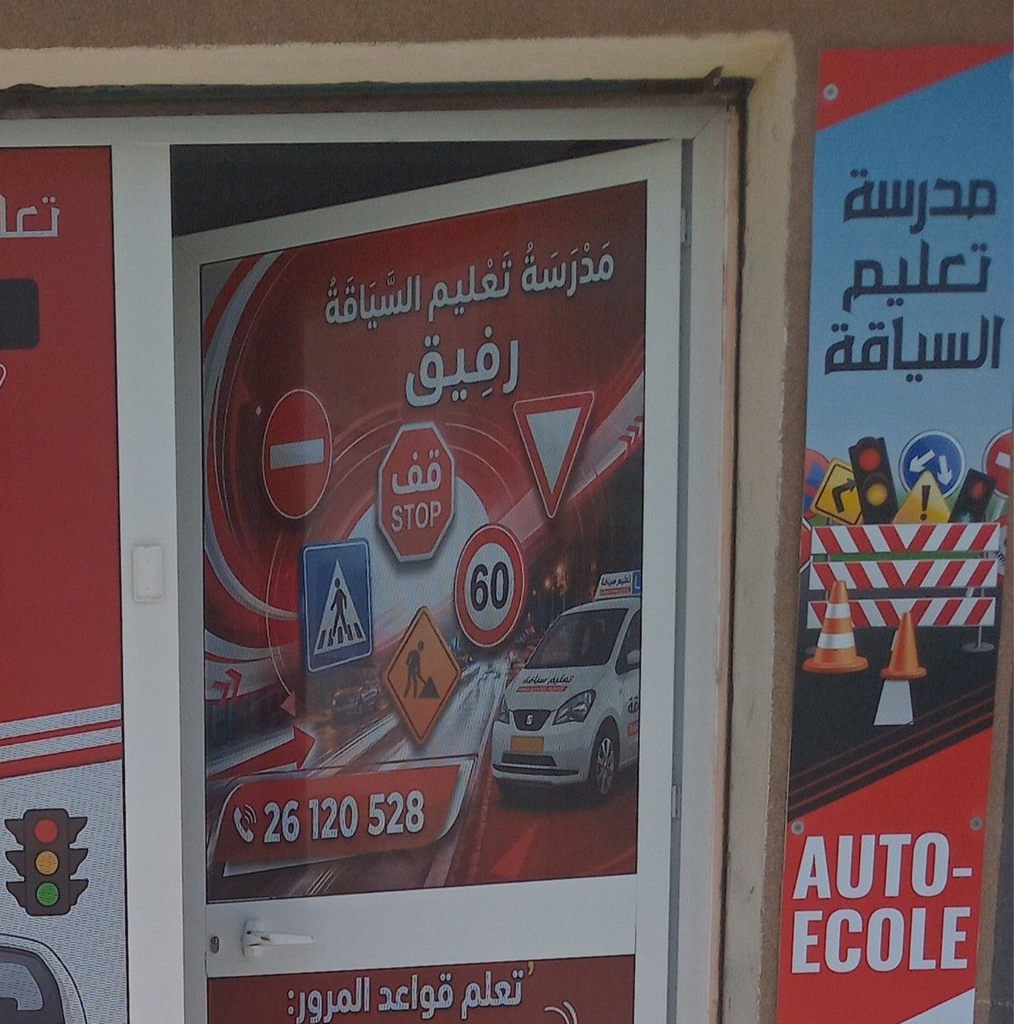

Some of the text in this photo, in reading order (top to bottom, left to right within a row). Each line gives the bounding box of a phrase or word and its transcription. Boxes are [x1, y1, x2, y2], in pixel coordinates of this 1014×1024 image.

[843, 168, 997, 234] مدرسة
[842, 239, 991, 313] تعليم
[824, 315, 1005, 382] السياقة
[392, 449, 442, 494] قف
[391, 501, 442, 531] STOP
[470, 561, 509, 612] 60
[264, 790, 425, 843] 26 120 528
[793, 832, 972, 900] AUTO-
[792, 906, 971, 974] ECOLE
[378, 973, 453, 1020] قواعد
